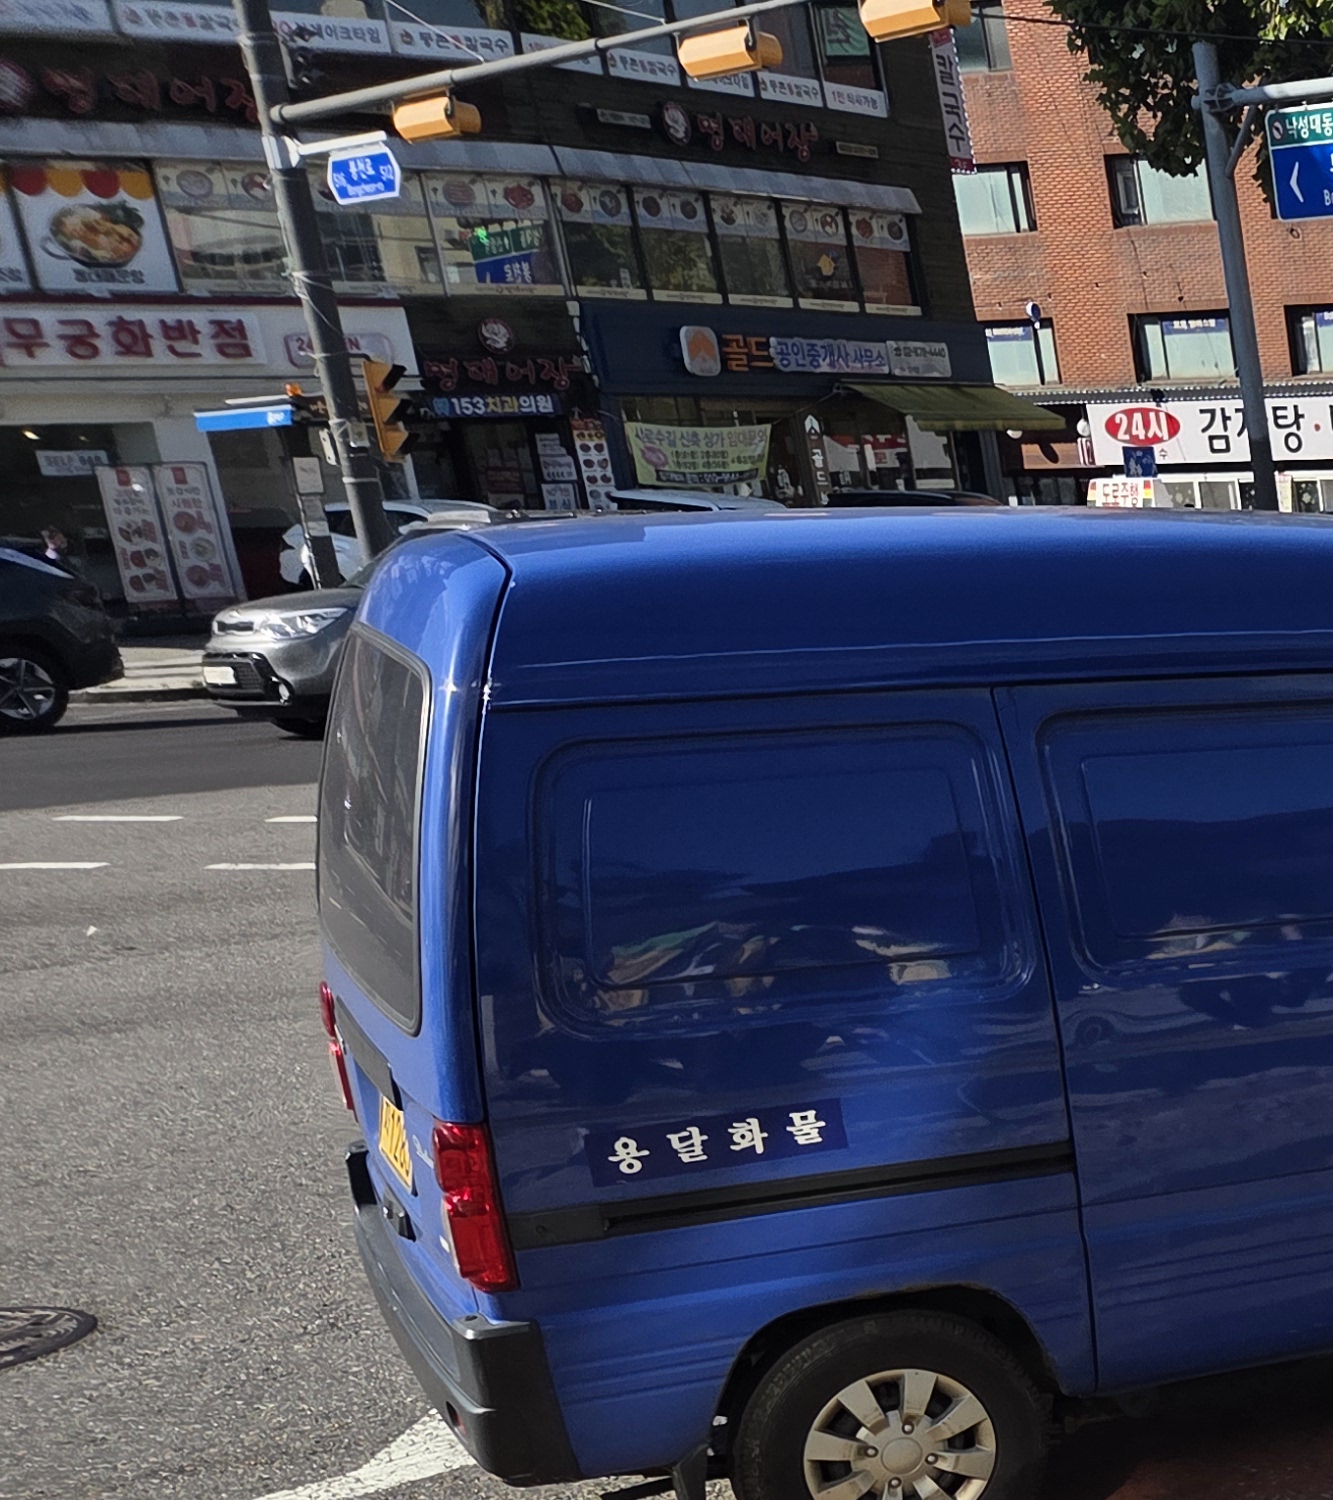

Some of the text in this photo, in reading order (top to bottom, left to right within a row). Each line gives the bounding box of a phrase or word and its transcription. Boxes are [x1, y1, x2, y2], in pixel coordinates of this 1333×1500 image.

[936, 53, 966, 152] 칼국수
[1286, 113, 1333, 140] 낙성대동
[3, 315, 253, 360] 무궁화반점
[722, 334, 886, 371] 골드 공인중개사 사무소
[453, 396, 555, 416] 153치과의원
[1115, 411, 1169, 441] 24시
[1199, 404, 1305, 453] 감탕
[1103, 482, 1140, 506] 도로주행
[607, 1109, 826, 1175] 용달화물
